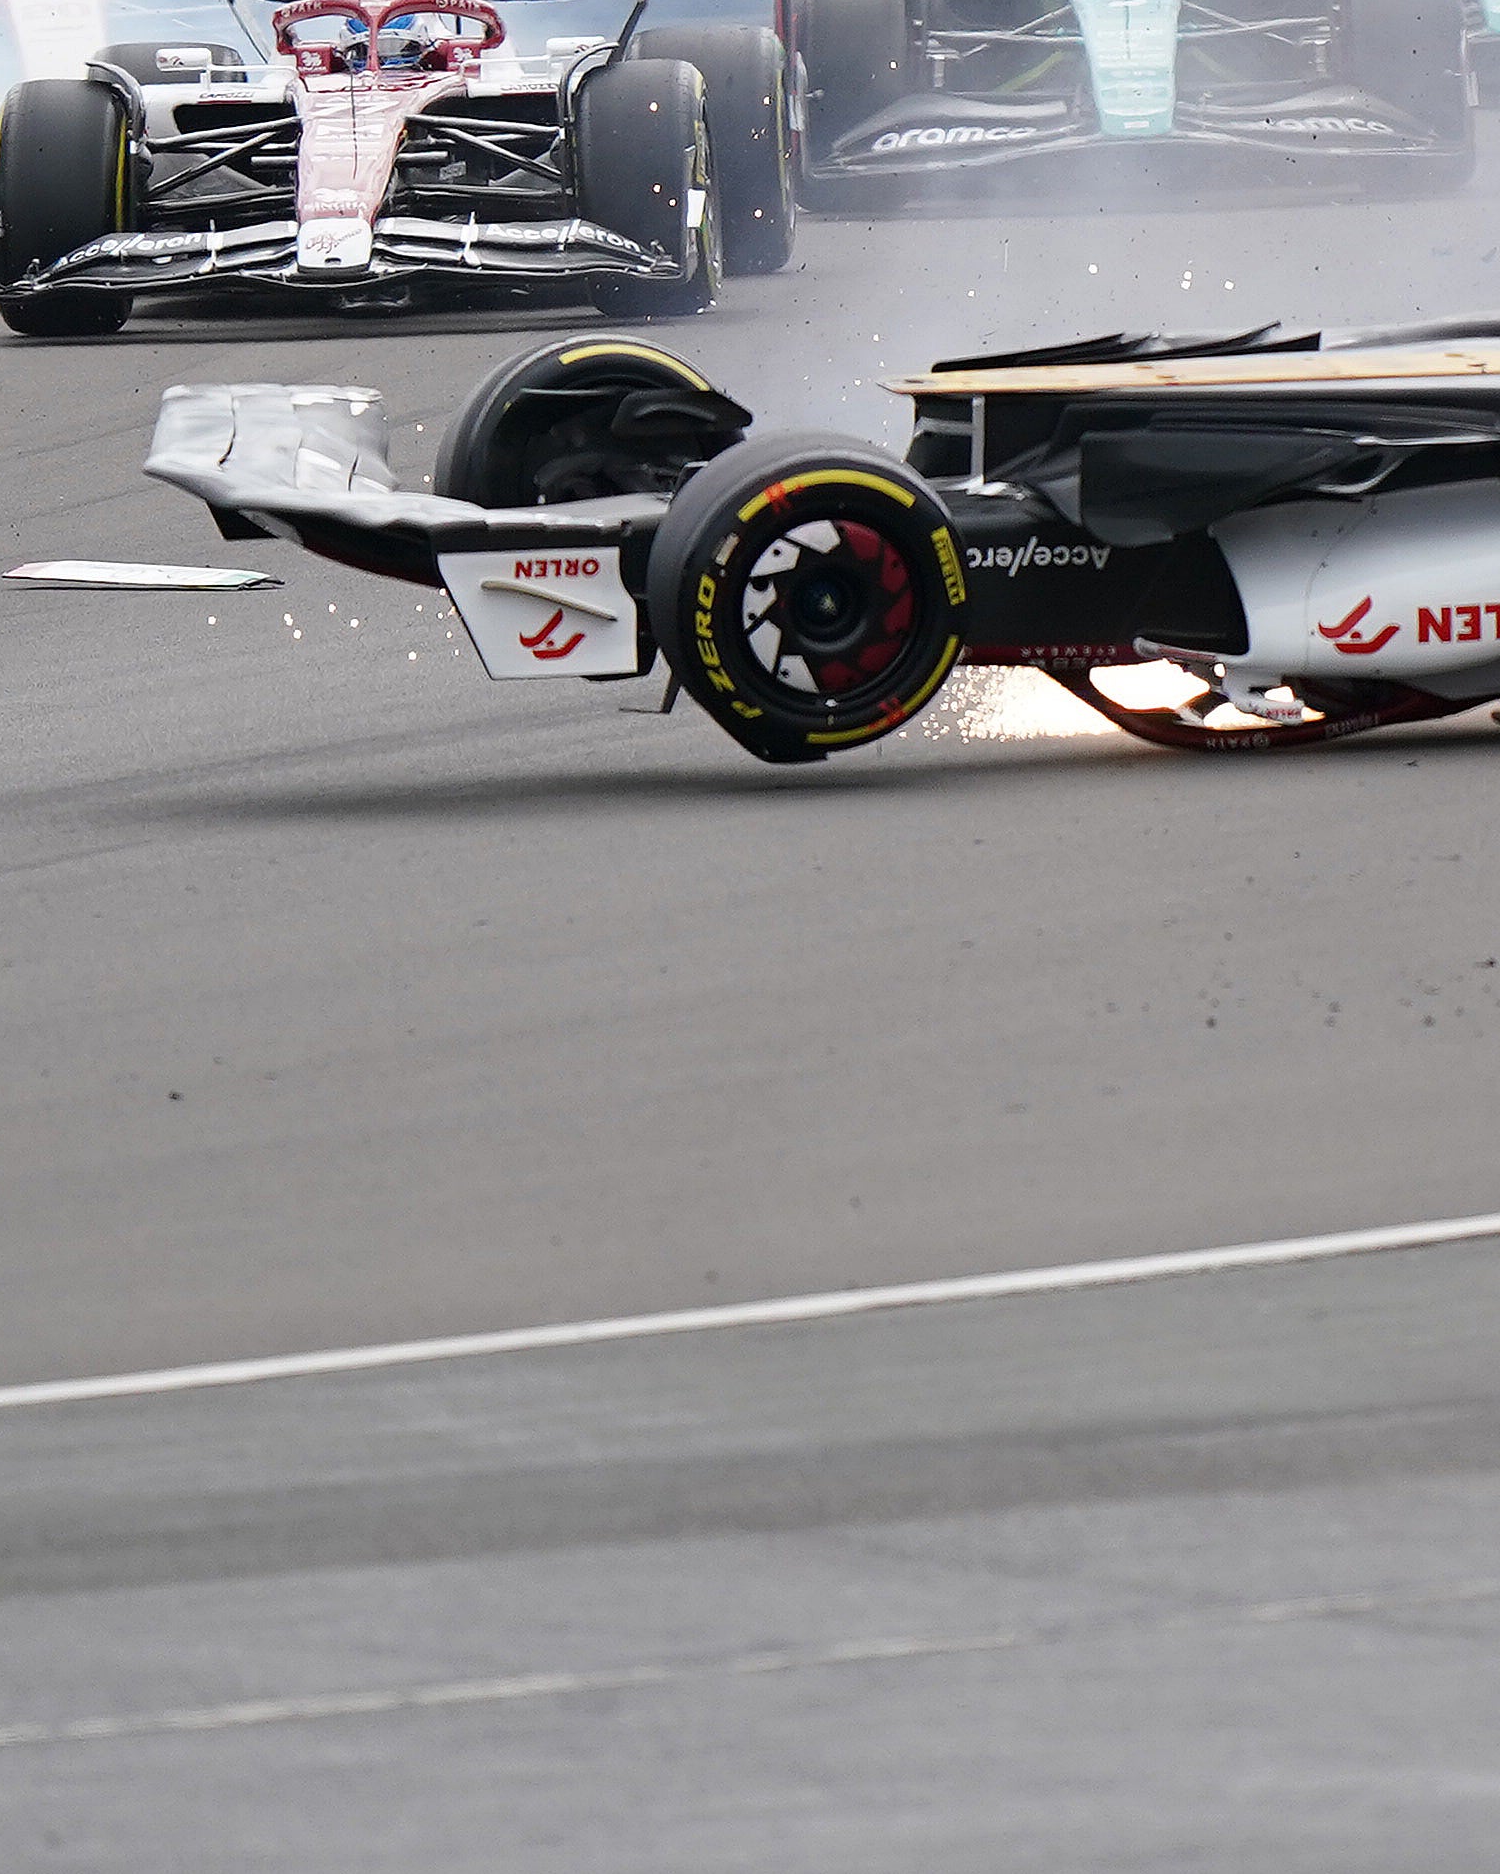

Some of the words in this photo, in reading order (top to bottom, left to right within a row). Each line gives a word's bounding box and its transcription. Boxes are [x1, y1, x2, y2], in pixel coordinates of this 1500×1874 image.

[872, 126, 1037, 151] aramco
[514, 557, 600, 579] ORLEN
[694, 574, 737, 693] ZERO
